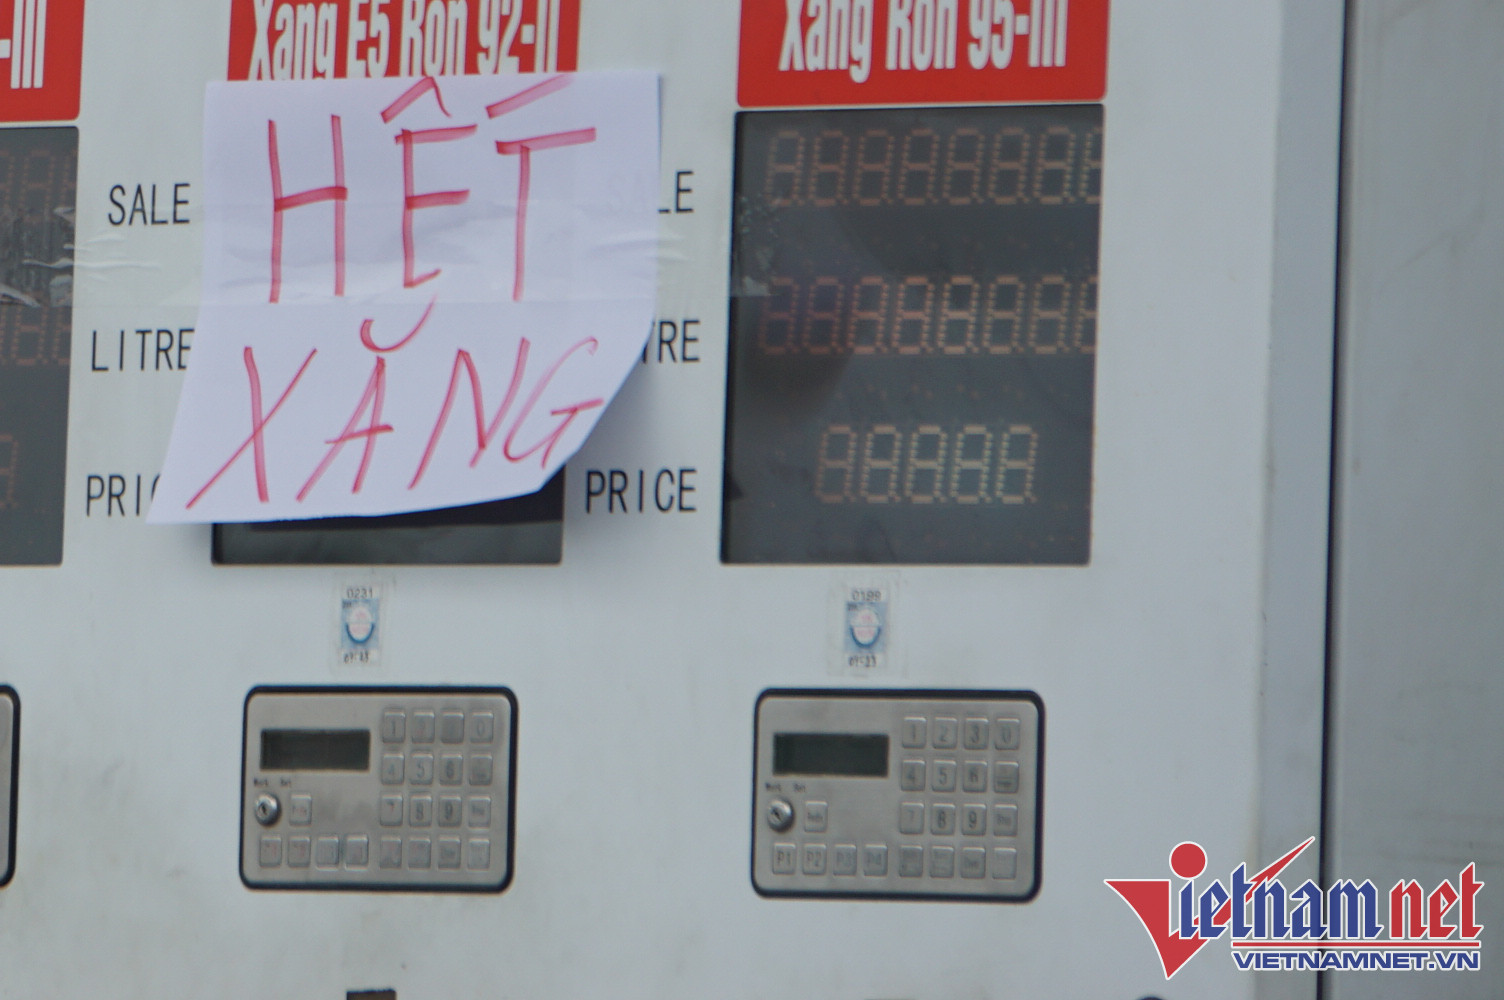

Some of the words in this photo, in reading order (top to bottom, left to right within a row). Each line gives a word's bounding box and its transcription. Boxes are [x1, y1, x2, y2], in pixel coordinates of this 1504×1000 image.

[107, 182, 190, 227] SALE
[266, 76, 596, 304] HẾT
[91, 328, 195, 372] LITRE
[185, 293, 604, 510] XĂNG
[86, 474, 160, 517] PRI
[584, 468, 697, 513] PRICE
